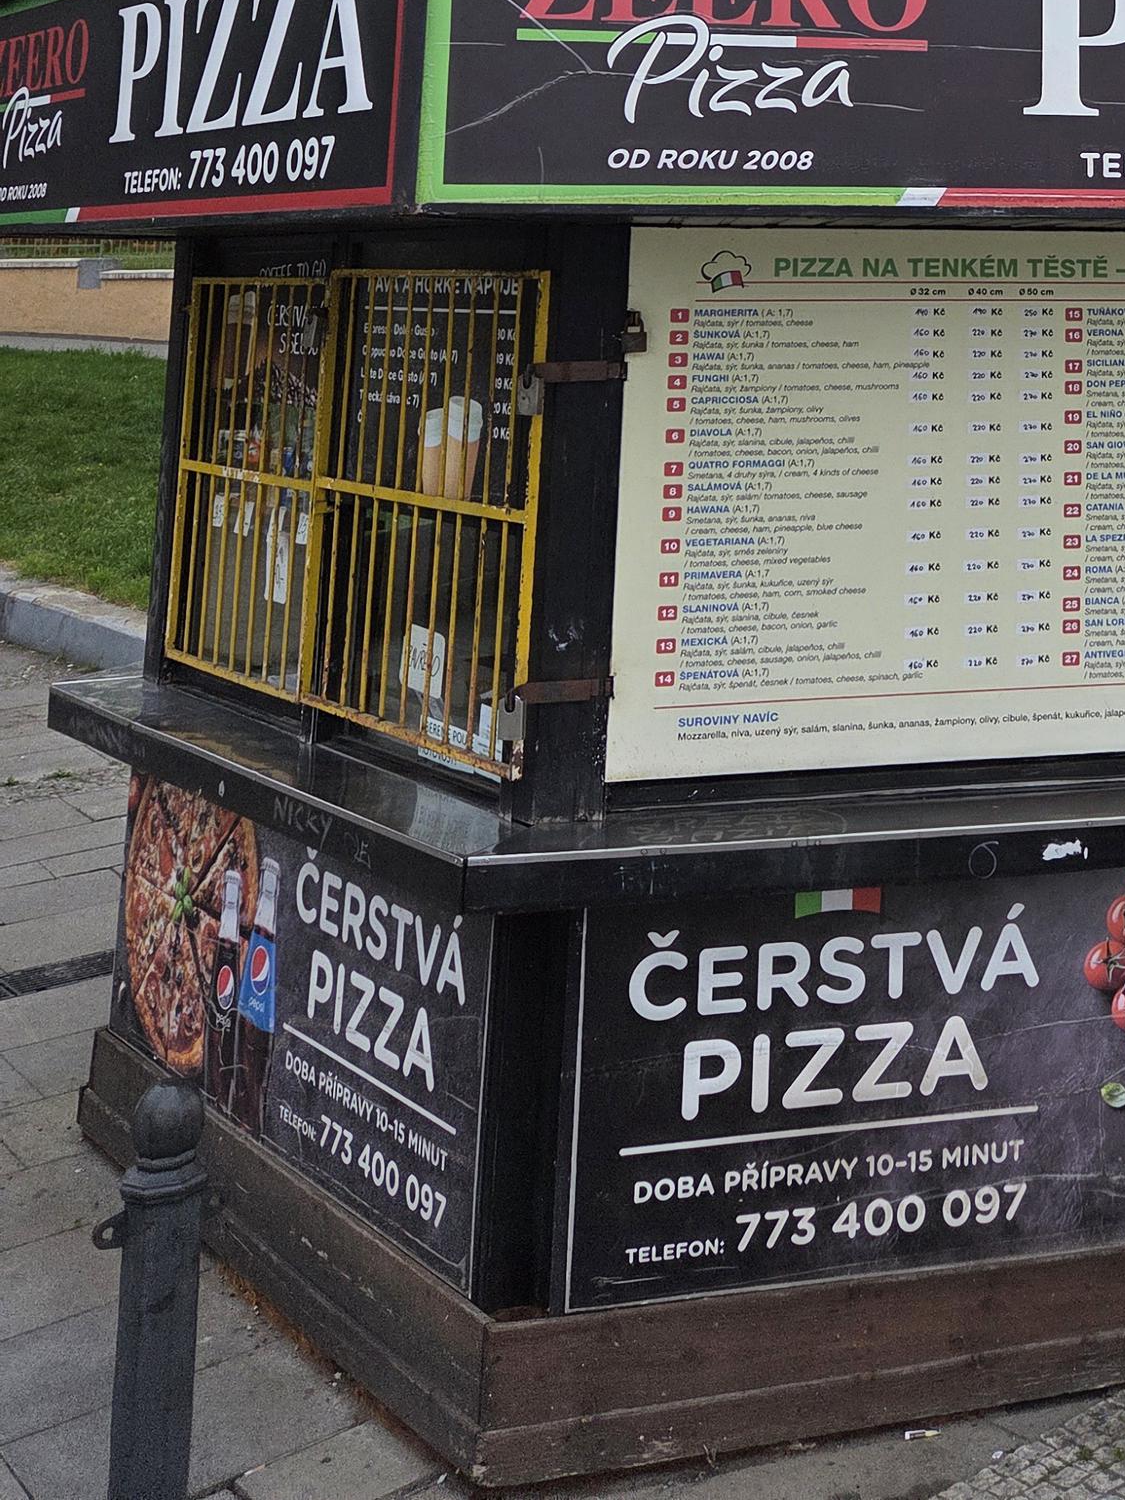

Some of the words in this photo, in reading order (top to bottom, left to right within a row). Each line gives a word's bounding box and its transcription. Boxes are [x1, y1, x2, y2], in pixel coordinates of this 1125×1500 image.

[606, 14, 854, 125] Pizza
[1, 85, 63, 170] Pizza
[124, 167, 181, 193] TELEFON:
[188, 148, 226, 188] 773
[231, 142, 279, 185] 400
[287, 136, 335, 181] 097
[608, 149, 649, 168] OD
[657, 150, 738, 169] ROKU
[743, 151, 813, 170] 2008
[27, 182, 47, 199] 2008
[774, 258, 853, 277] PIZZA
[863, 258, 899, 277] NA
[907, 254, 1017, 278] TENKÉM
[1027, 255, 1108, 278] TĚSTĚ
[677, 311, 683, 320] 1
[694, 309, 759, 317] MARGHERITA
[1068, 310, 1081, 319] 15
[675, 333, 683, 342] 2
[693, 329, 740, 338] ŠUNKOVÁ
[743, 330, 770, 340] (A:1,7)
[843, 339, 859, 347] ham
[1068, 331, 1081, 340] 16
[674, 355, 682, 365] 3
[1068, 362, 1080, 371] 17
[673, 378, 681, 387] 4
[692, 374, 729, 382] FUNGHI
[1067, 383, 1080, 392] 18
[672, 400, 681, 409] 5
[691, 396, 759, 404] CAPRICCIOSA
[762, 395, 788, 404] (A:1,7)
[932, 392, 944, 401] Kč
[990, 392, 1002, 401] Kč
[1041, 391, 1052, 401] Kč
[1067, 412, 1080, 422] 19
[1100, 409, 1122, 418] NIÑO
[671, 431, 679, 441] 6
[690, 429, 732, 437] DIAVOLA
[1087, 441, 1104, 449] SAN
[670, 464, 678, 474] 7
[688, 460, 729, 469] QUATRO
[732, 459, 785, 468] FORMAGGI
[1086, 472, 1098, 480] DE
[1101, 472, 1112, 480] LA
[669, 487, 677, 497] 8
[688, 481, 742, 491] SALÁMOVÁ
[668, 509, 676, 519] 9
[687, 505, 730, 514] HAWANA
[1086, 503, 1124, 511] CATANIA
[664, 541, 678, 551] 10
[685, 537, 755, 547] VEGETARIANA
[758, 536, 785, 546] (A:1,7)
[1067, 538, 1079, 546] 23
[662, 575, 675, 585] 11
[684, 570, 742, 580] PRIMAVERA
[1066, 569, 1078, 577] 24
[1085, 566, 1113, 574] ROMA
[1085, 597, 1119, 605] BIANCA
[661, 608, 675, 618] 12
[683, 602, 739, 613] SLANINOVÁ
[1085, 619, 1103, 627] SAN
[659, 641, 674, 651] 13
[681, 636, 728, 646] MEXICKÁ
[1065, 654, 1078, 662] 27
[658, 674, 672, 684] 14
[680, 668, 739, 680] ŠPENÁTOVÁ
[742, 668, 769, 679] (A:1,7)
[678, 715, 739, 727] SUROVINY
[743, 711, 778, 723] NAVÍC
[678, 731, 728, 740] Mozzarella,
[731, 729, 752, 738] niva,
[755, 727, 781, 737] uzený
[784, 726, 798, 736] sýr,
[801, 724, 829, 733] salám,
[833, 723, 865, 732] slanina,
[868, 721, 896, 730] šunka,
[899, 720, 932, 728] ananas,
[935, 717, 976, 726] žampiony,
[979, 716, 1000, 724] olivy,
[1003, 714, 1030, 722] cibule,
[1033, 712, 1063, 722] špenát,
[1065, 710, 1102, 719] kukuřice,
[296, 846, 465, 1006] ČERSTVÁ
[629, 902, 1040, 1021] ČERSTVÁ
[307, 949, 434, 1093] PIZZA
[682, 1015, 988, 1121] PIZZA
[285, 1051, 316, 1086] DOBA
[318, 1071, 373, 1123] PŘÍPRAVY
[376, 1108, 405, 1144] 10-15
[408, 1130, 448, 1171] MINUT
[279, 1105, 317, 1142] TELEFON:
[320, 1114, 353, 1165] 773
[358, 1144, 399, 1197] 400
[406, 1174, 446, 1228] 097
[634, 1174, 714, 1204] DOBA
[725, 1157, 858, 1193] PŘÍPRAVY
[866, 1149, 932, 1177] 10-15
[943, 1139, 1024, 1169] MINUT
[625, 1241, 724, 1265] TELEFON:
[736, 1207, 815, 1252] 773
[832, 1194, 925, 1238] 400
[943, 1180, 1027, 1227] 097
